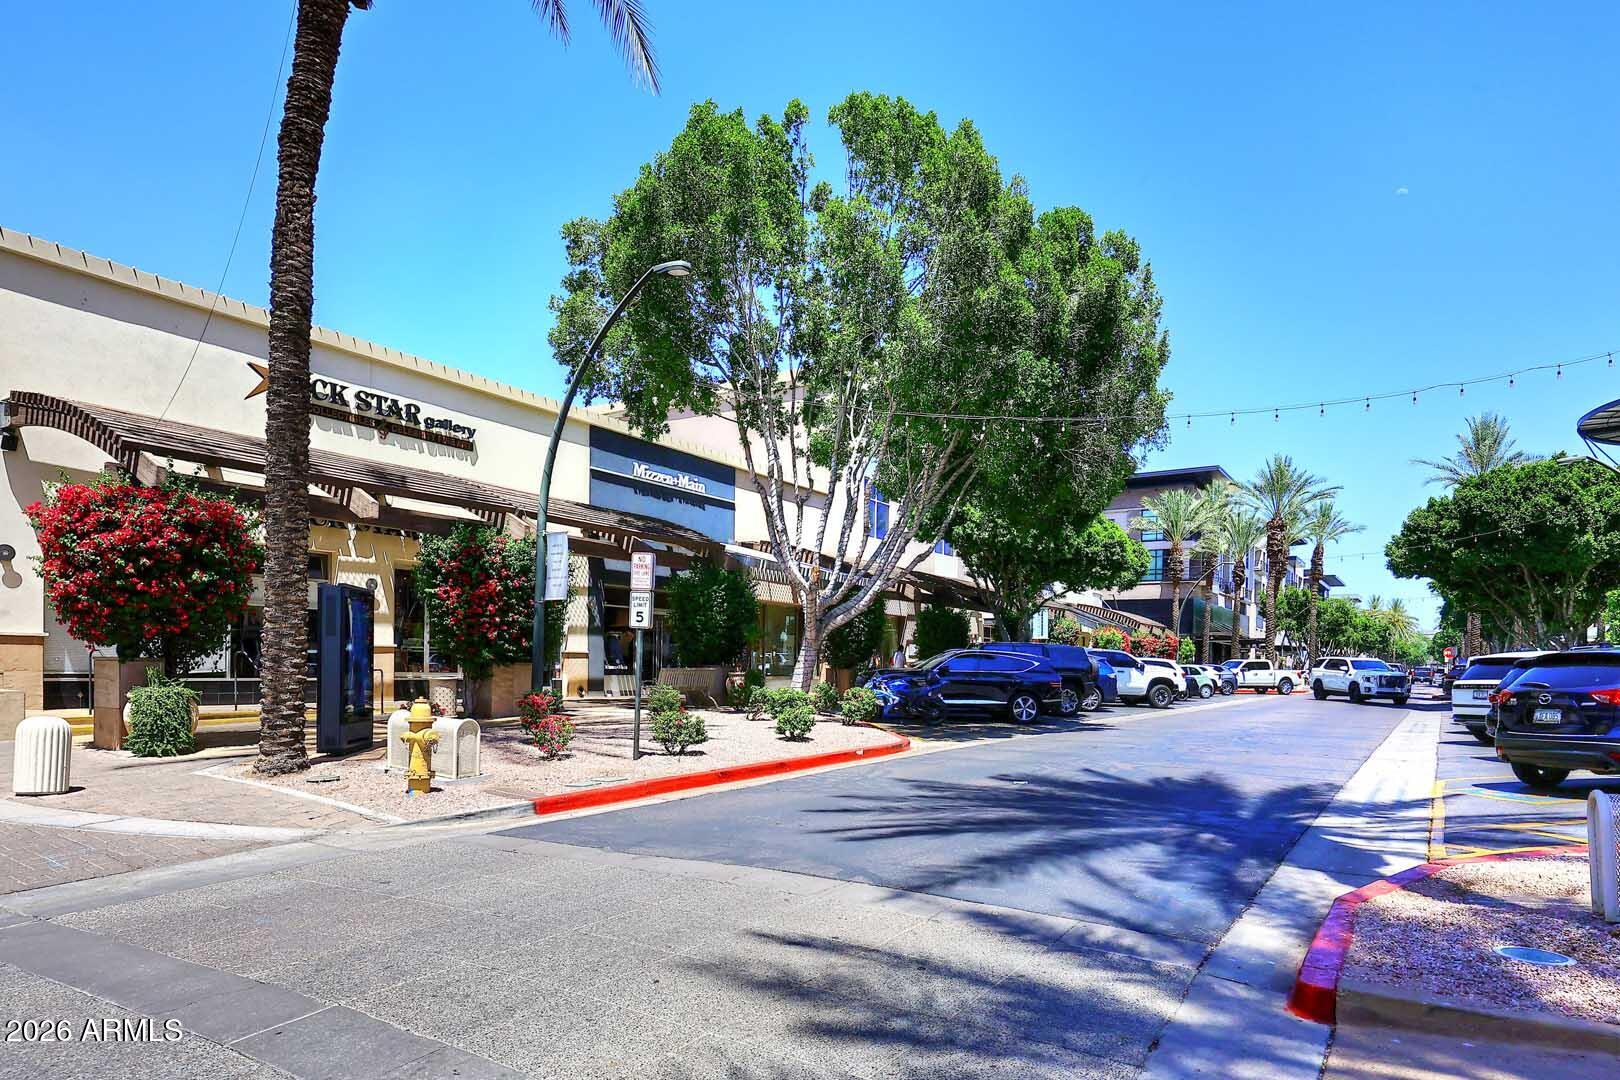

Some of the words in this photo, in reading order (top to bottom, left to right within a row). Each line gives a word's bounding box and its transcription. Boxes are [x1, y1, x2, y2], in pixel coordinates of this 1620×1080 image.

[311, 379, 350, 408] CK
[354, 390, 421, 425] STAR
[424, 417, 476, 439] gallery
[312, 406, 376, 427] OLLECTIBLES
[636, 611, 644, 623] 5
